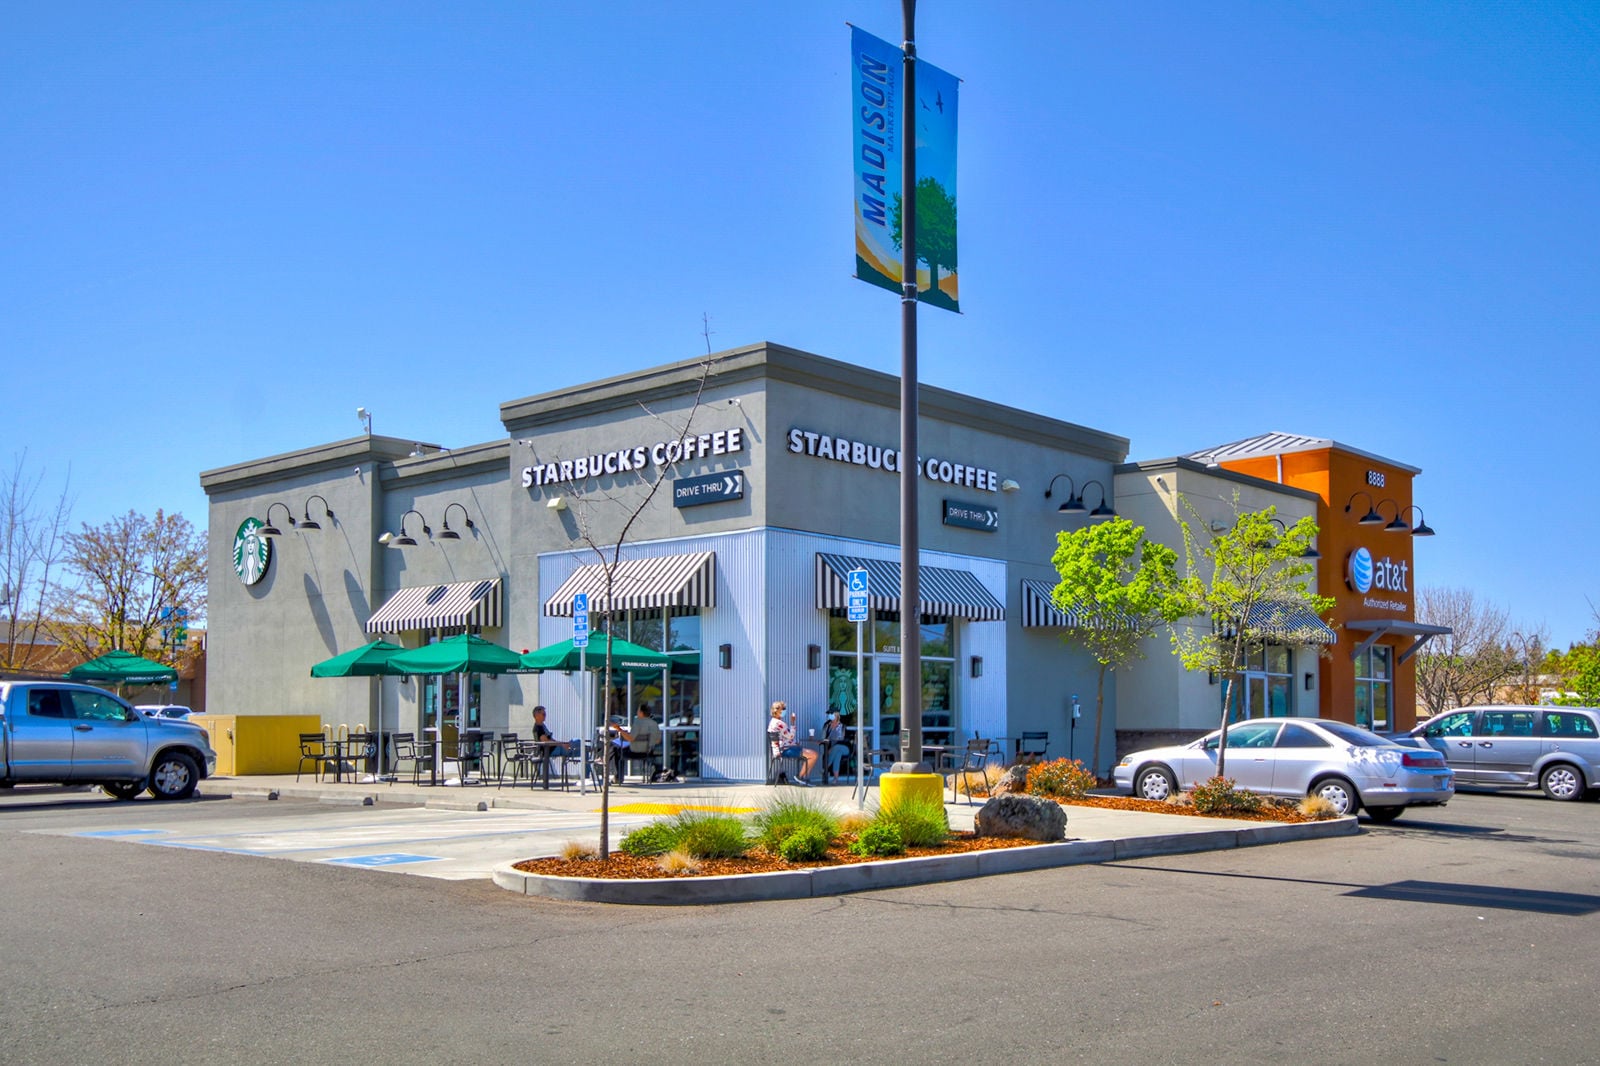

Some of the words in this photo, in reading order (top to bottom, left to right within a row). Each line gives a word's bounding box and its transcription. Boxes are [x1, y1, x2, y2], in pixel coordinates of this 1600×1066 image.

[887, 66, 895, 153] MARKETPLACE
[861, 53, 888, 228] MADISON
[521, 446, 647, 488] STARBUCKS
[651, 428, 743, 466] COFFEE
[926, 458, 998, 492] COFFEE
[676, 485, 700, 498] DRIVE
[701, 481, 723, 494] THRU
[1367, 470, 1385, 488] 8888
[949, 507, 968, 519] DRIVE
[969, 511, 986, 522] THRU
[1375, 557, 1408, 593] at&t
[1363, 597, 1389, 609] Authorized
[1390, 600, 1407, 612] Retailer
